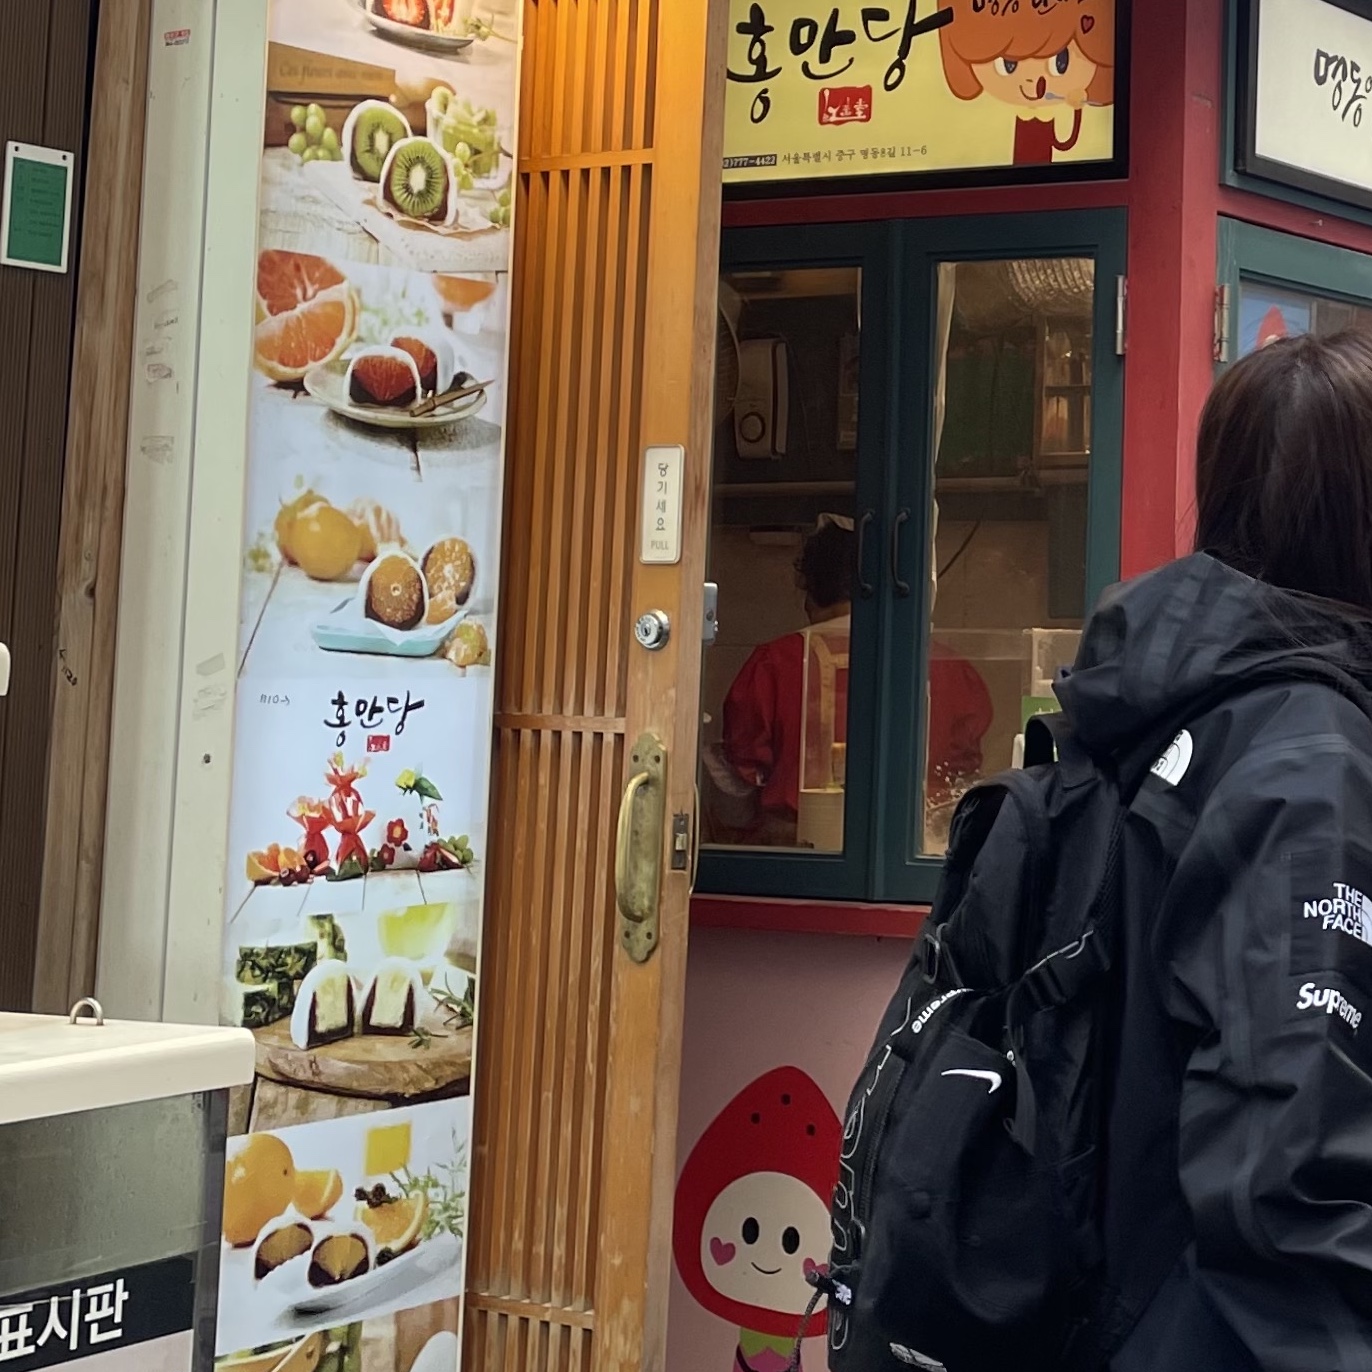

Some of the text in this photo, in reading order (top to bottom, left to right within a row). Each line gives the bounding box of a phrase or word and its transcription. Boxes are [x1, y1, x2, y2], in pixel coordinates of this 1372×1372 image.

[727, 0, 953, 124] 홍만당
[782, 152, 832, 164] 서울특별시
[835, 149, 856, 161] 중구
[900, 145, 927, 156] 11-6
[655, 462, 669, 532] 당기세요
[650, 541, 669, 551] PULL
[323, 690, 425, 747] 홍만당
[1304, 897, 1362, 921] NORTH
[1333, 882, 1363, 908] THE
[1322, 914, 1362, 938] FACE
[1296, 982, 1362, 1030] Supreme
[0, 1278, 129, 1361] 표시판
